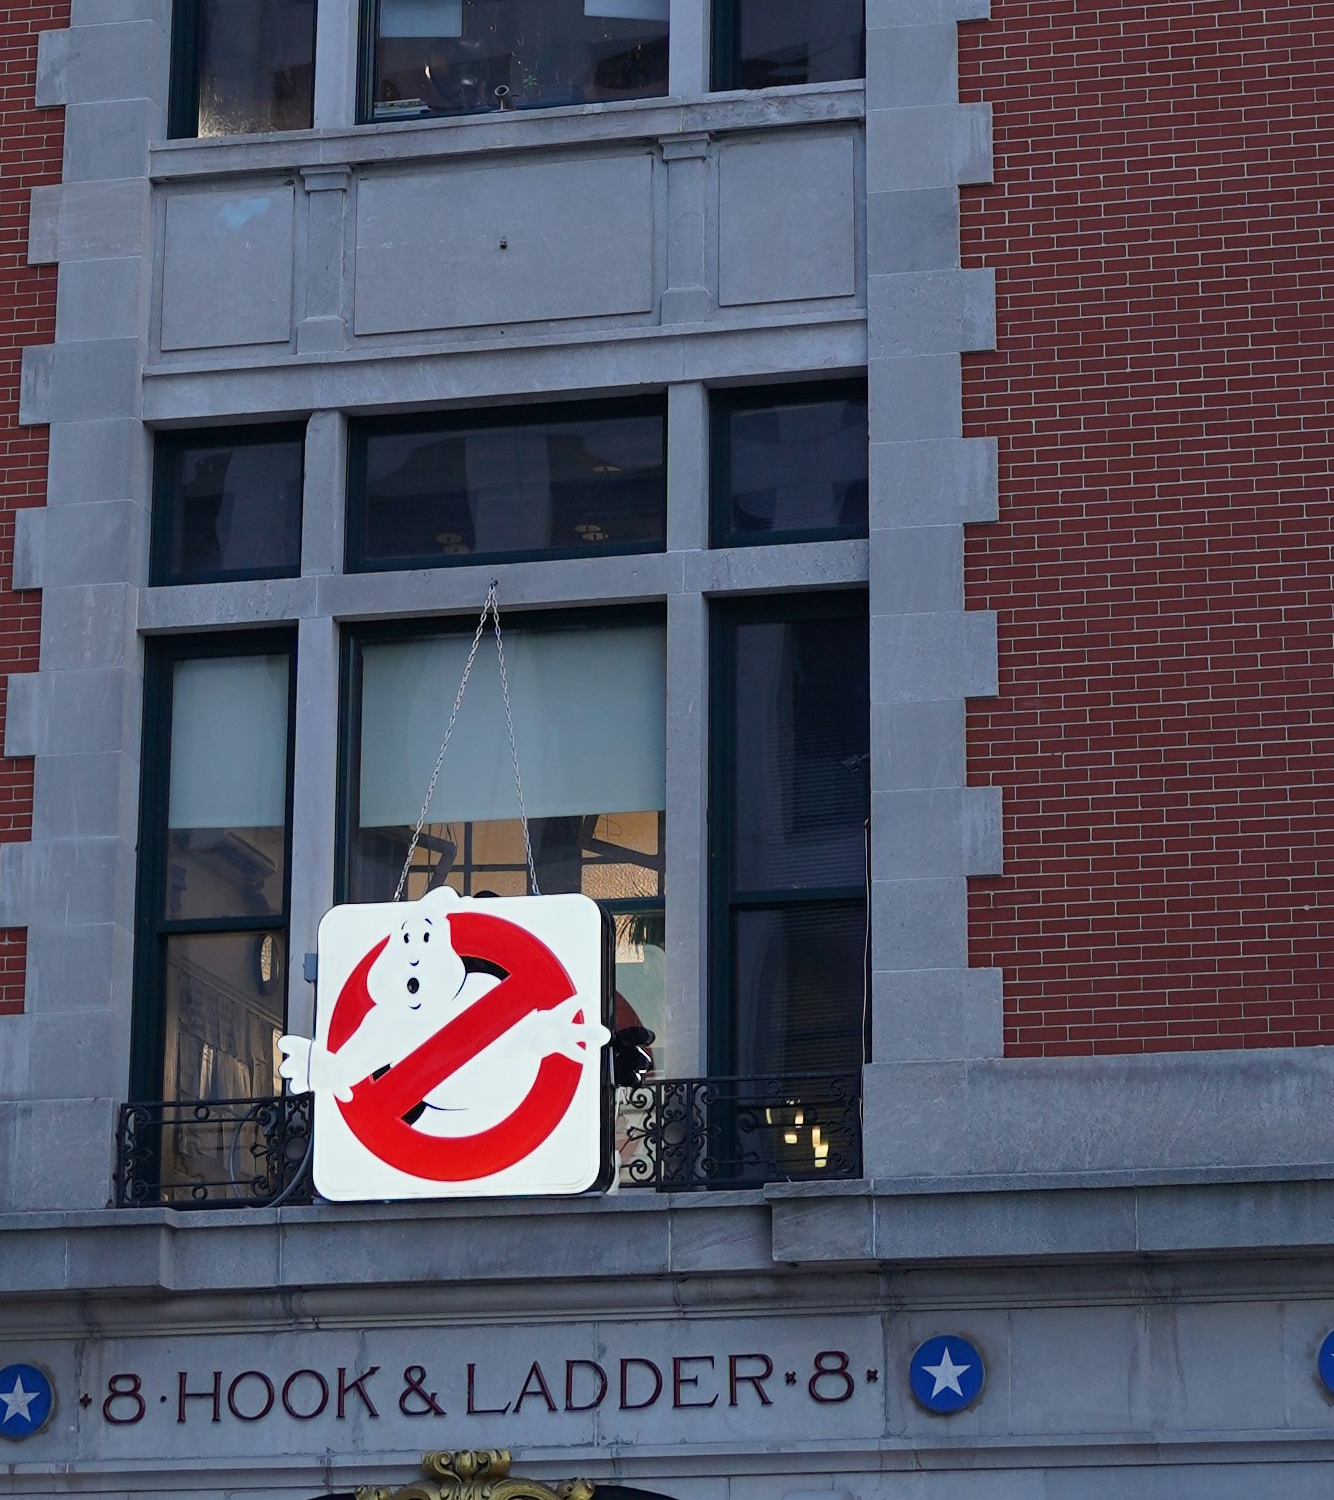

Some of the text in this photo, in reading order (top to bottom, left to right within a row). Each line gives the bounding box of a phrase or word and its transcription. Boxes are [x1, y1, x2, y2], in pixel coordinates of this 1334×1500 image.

[176, 1366, 381, 1423] HOOK
[398, 1364, 447, 1417] &
[466, 1353, 774, 1416] LADDER
